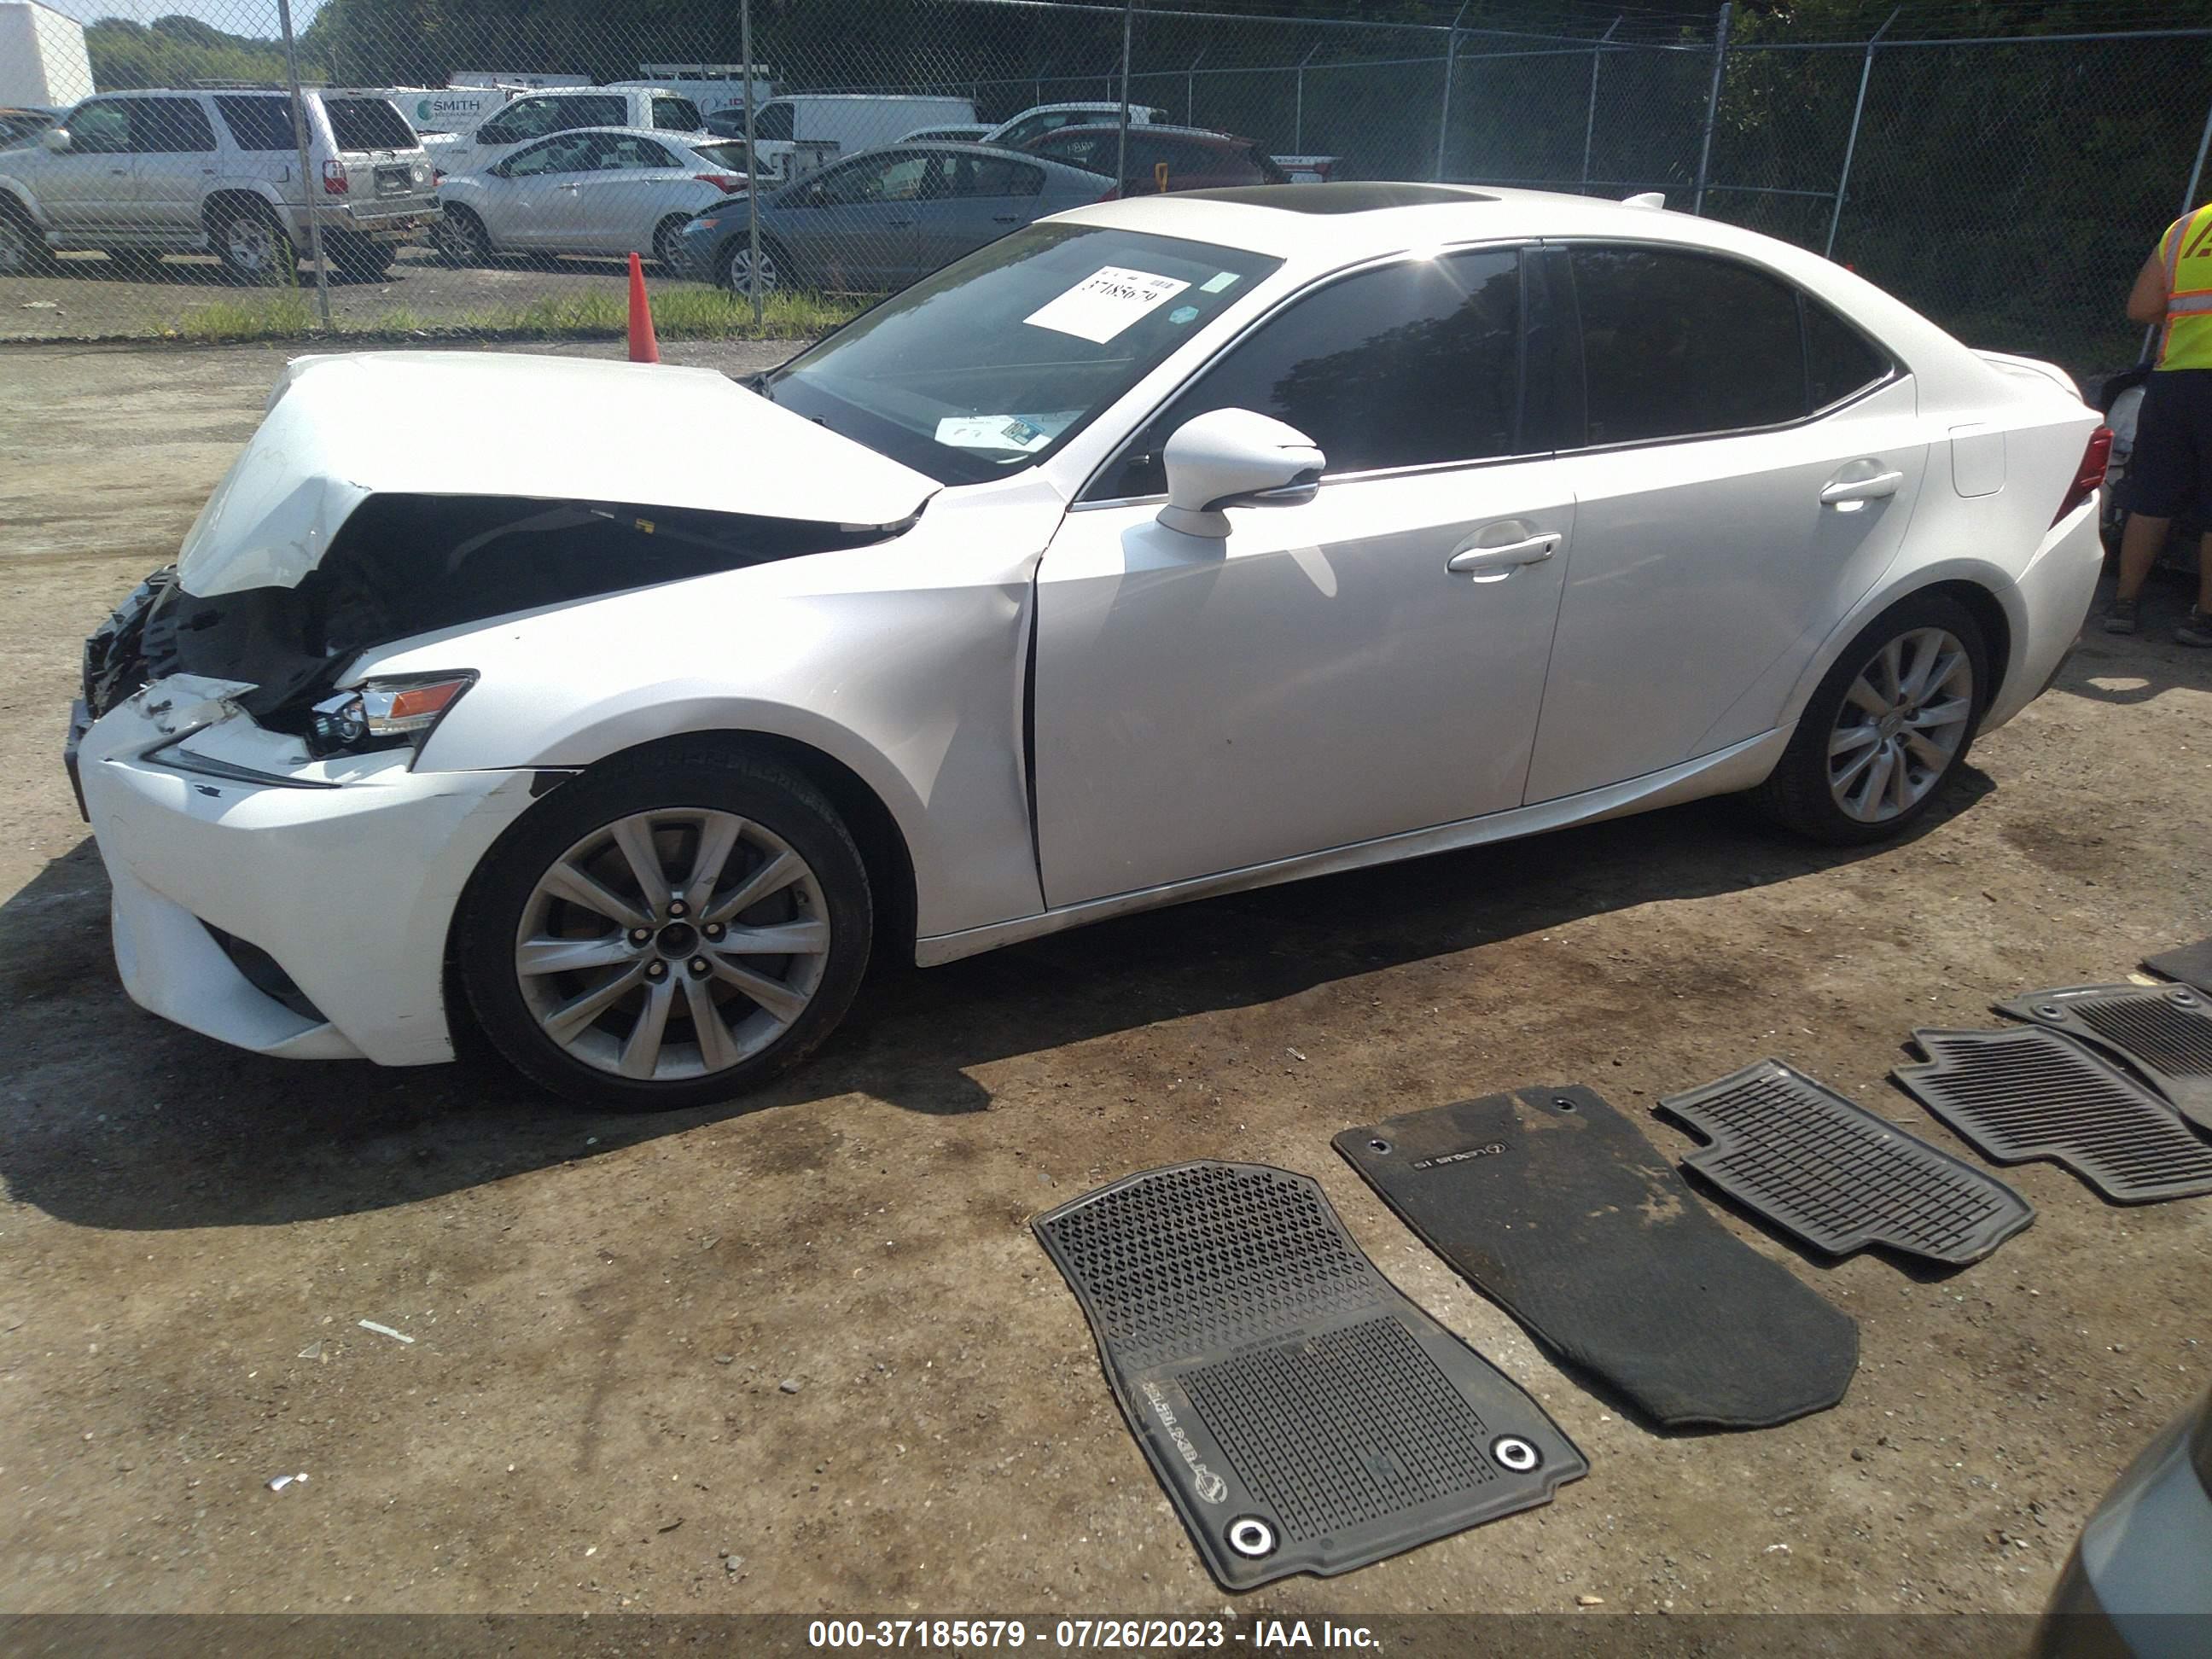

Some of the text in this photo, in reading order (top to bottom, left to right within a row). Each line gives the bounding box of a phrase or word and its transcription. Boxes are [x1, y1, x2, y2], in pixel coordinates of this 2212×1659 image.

[434, 101, 480, 111] SMITH
[1080, 279, 1159, 302] 37185679
[1414, 1149, 1487, 1169] LEXUS IS
